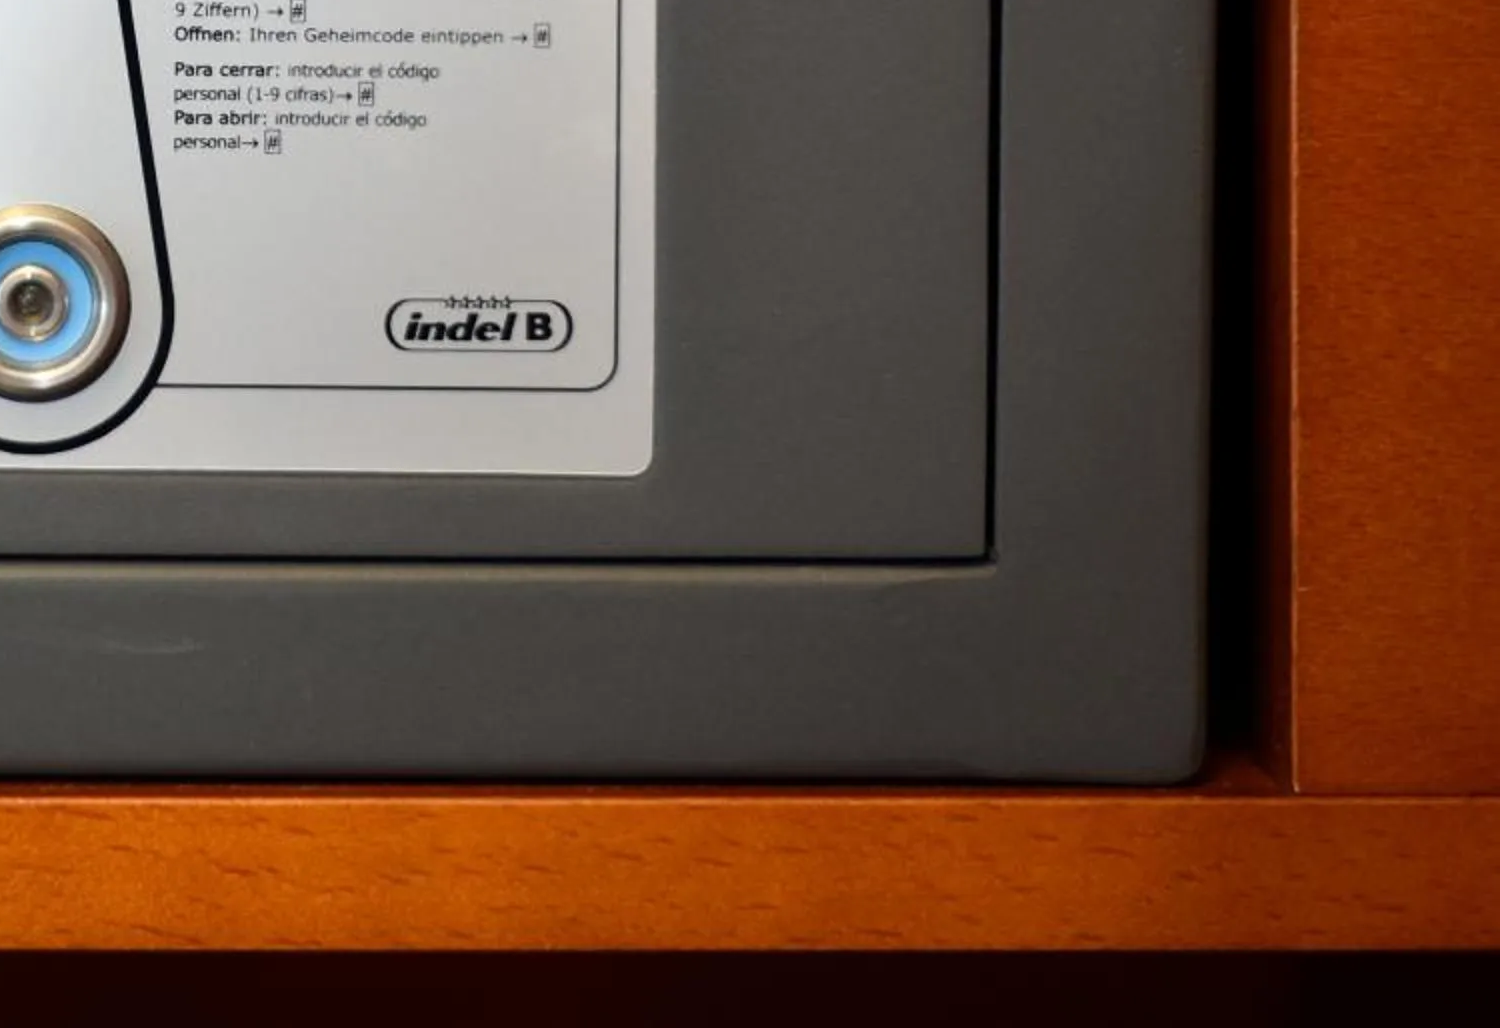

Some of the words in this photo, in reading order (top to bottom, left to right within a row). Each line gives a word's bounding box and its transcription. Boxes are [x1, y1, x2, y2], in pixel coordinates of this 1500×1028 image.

[174, 1, 188, 18] 9
[192, 0, 260, 22] Ziffern)
[249, 27, 298, 43] Ihren
[303, 27, 415, 44] Geheimcode
[420, 29, 505, 47] eintippen
[173, 60, 214, 78] Para
[218, 64, 280, 79] cerrar:
[286, 63, 364, 79] introducir
[367, 63, 384, 79] el
[387, 61, 441, 83] código
[173, 85, 242, 105] personal
[173, 109, 214, 126] Para
[217, 109, 268, 127] abrir:
[272, 110, 351, 127] introducir
[354, 110, 370, 128] el
[373, 109, 428, 131] código
[172, 134, 243, 152] personal
[404, 312, 517, 341] indel
[526, 312, 553, 341] B
